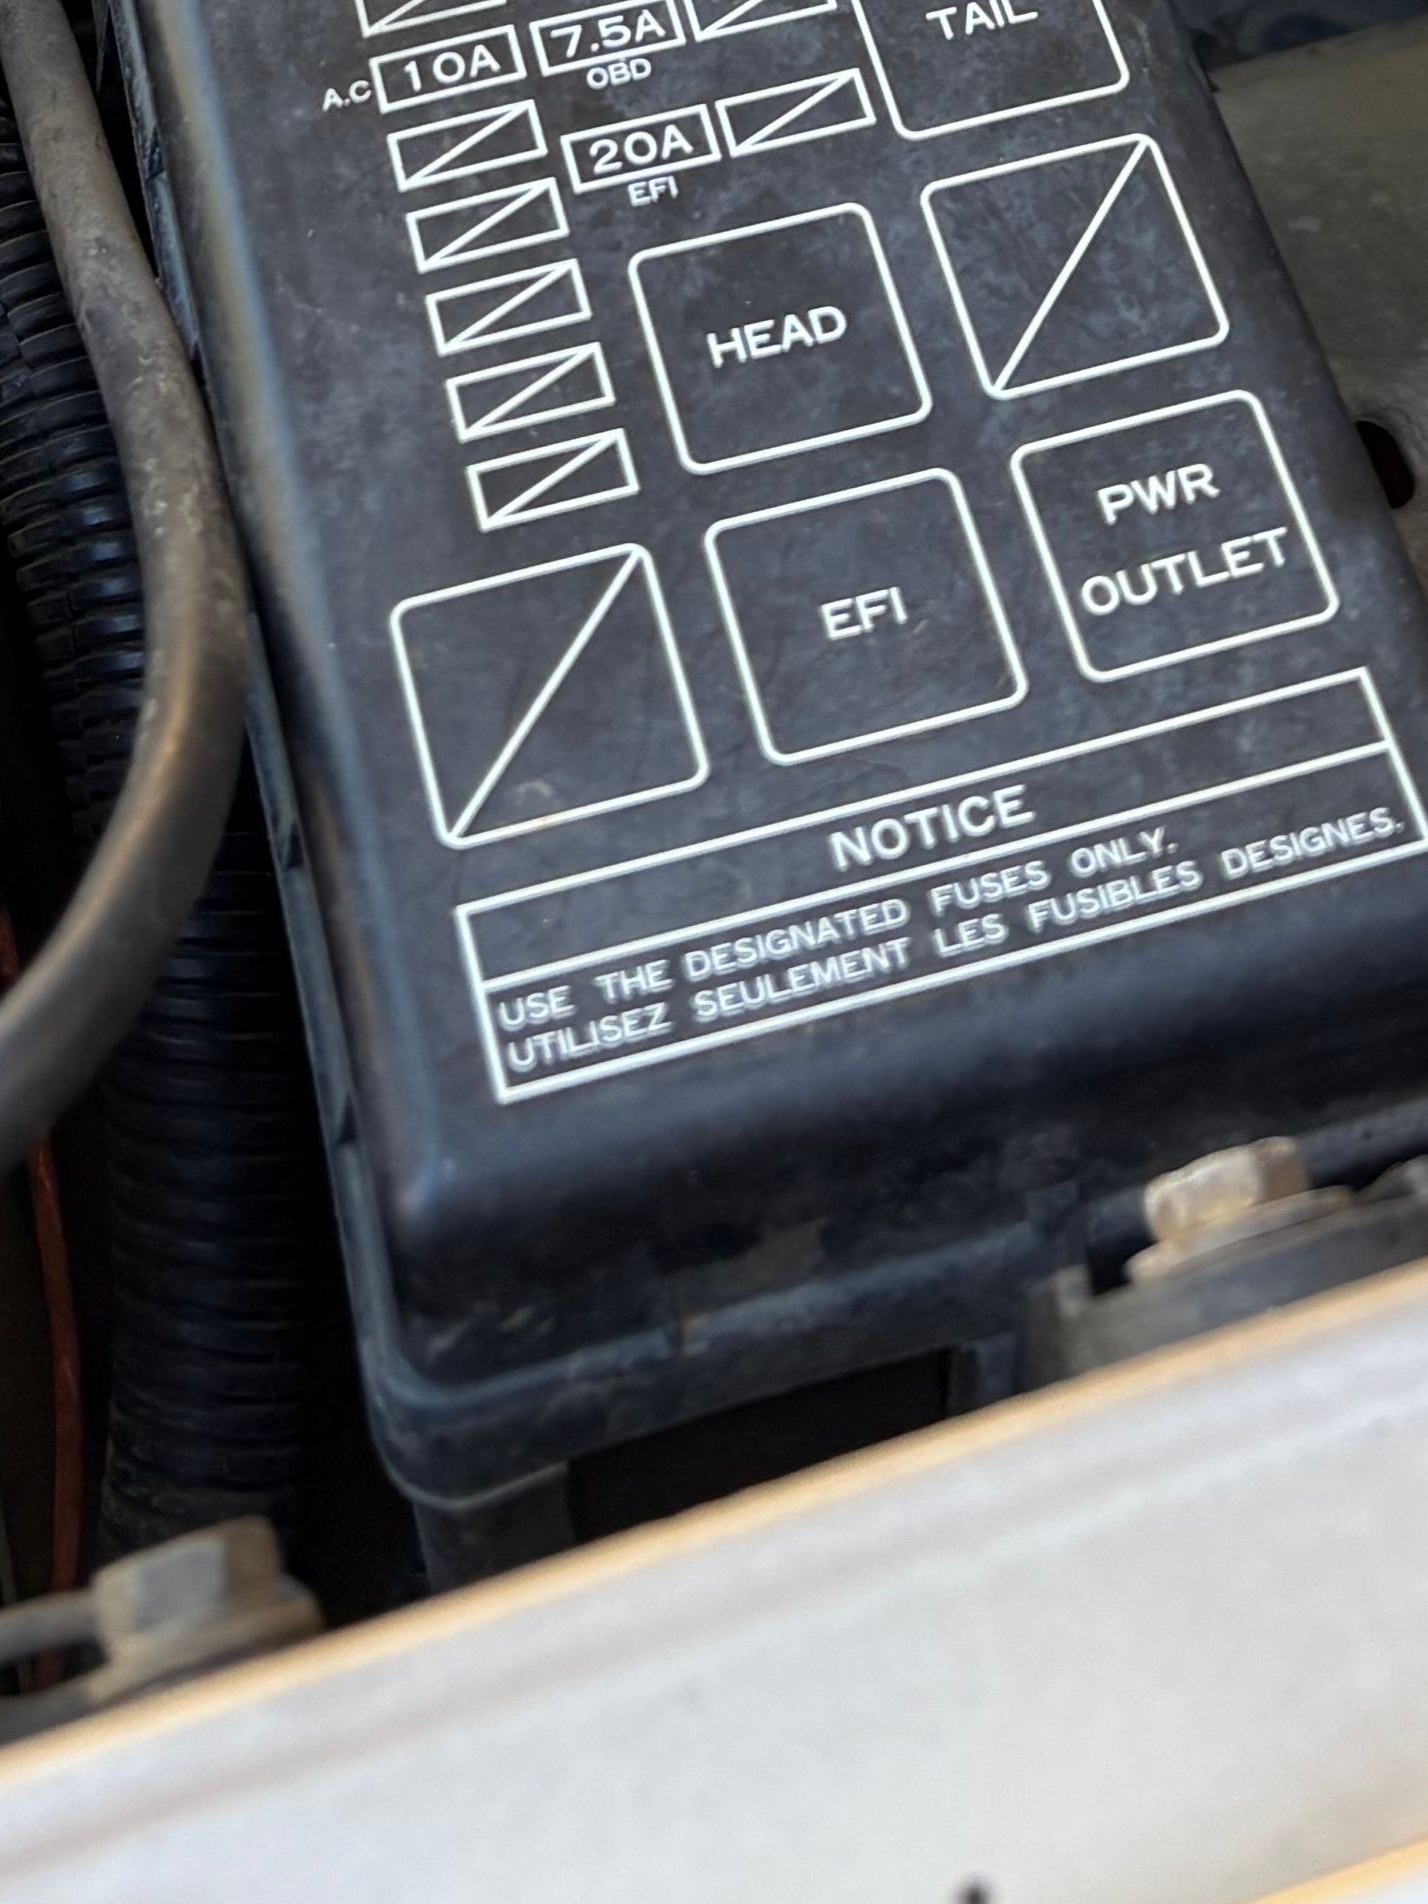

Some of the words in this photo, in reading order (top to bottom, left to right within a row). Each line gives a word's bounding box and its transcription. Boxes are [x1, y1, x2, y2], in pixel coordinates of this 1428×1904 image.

[550, 11, 666, 59] 7.5A
[404, 43, 501, 90] 10A
[585, 58, 652, 91] OBD
[589, 126, 694, 174] 20A
[628, 177, 678, 208] EFI
[706, 305, 847, 368] HEAD
[1096, 462, 1219, 524] PWR
[1080, 526, 1289, 616] OUTLET
[819, 587, 909, 641] EFI
[828, 784, 1036, 871] NOTICE
[498, 985, 575, 1030] USE
[595, 959, 673, 1004] THE
[683, 897, 911, 982] DESIGNATED
[930, 859, 1052, 917] FUSES
[1070, 826, 1180, 878] ONLY.
[506, 1002, 673, 1073] UTILISEZ
[691, 935, 912, 1024] SEULEMENT
[932, 912, 1010, 958] LES
[1025, 860, 1203, 934] FUSIBLES
[1220, 806, 1405, 880] DESIGNES.
